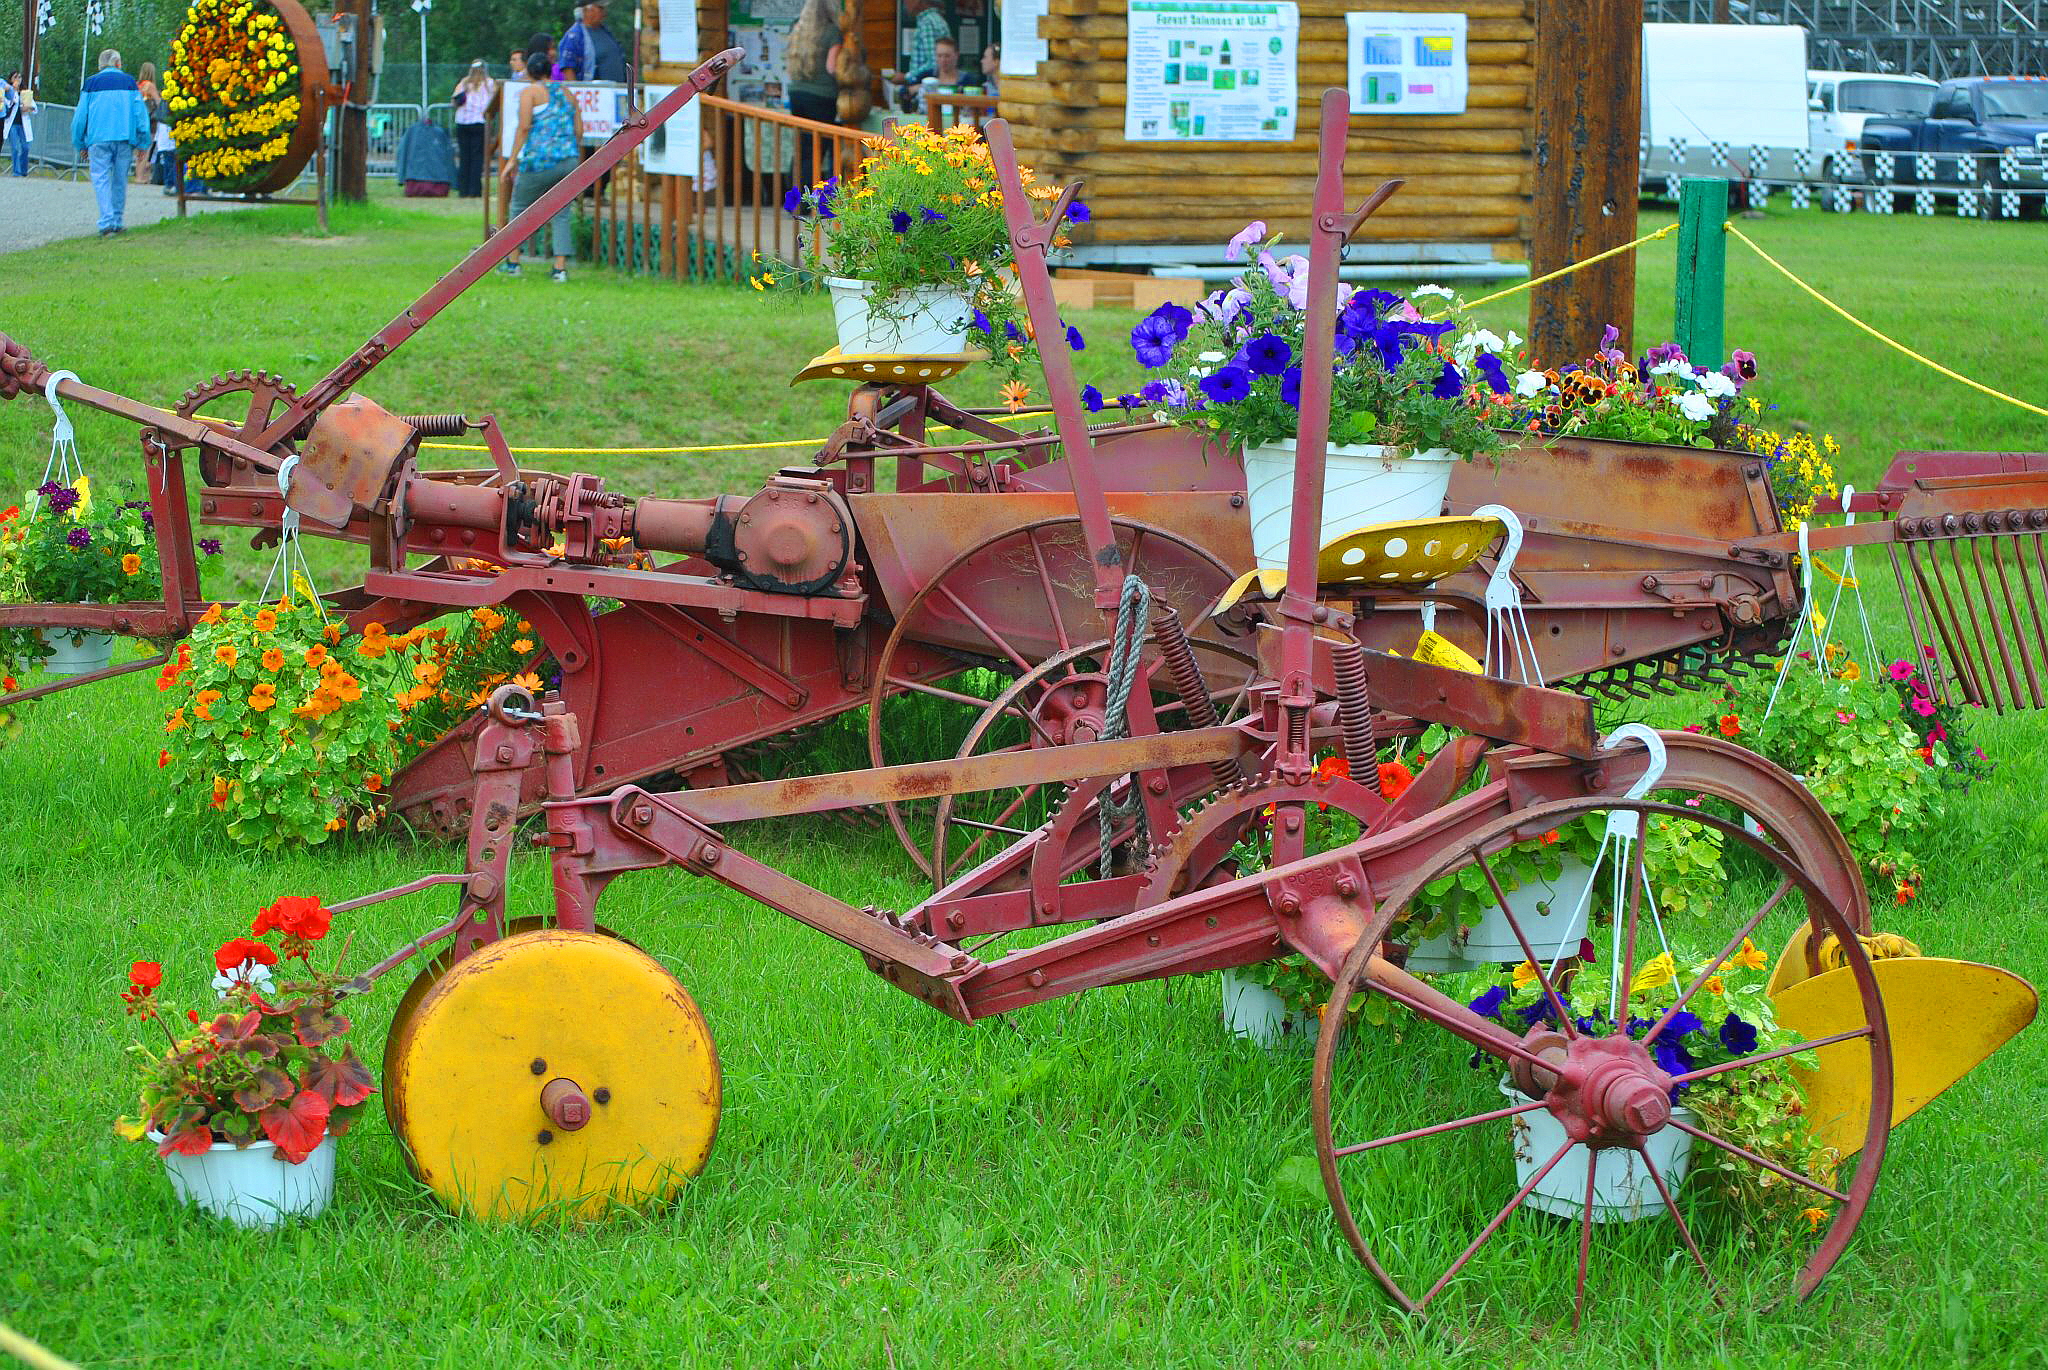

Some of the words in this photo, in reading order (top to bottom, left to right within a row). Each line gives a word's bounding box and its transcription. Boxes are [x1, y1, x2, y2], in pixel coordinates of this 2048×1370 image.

[1156, 13, 1188, 25] Forest
[1190, 14, 1233, 26] Sciences
[1235, 15, 1246, 26] at
[1248, 15, 1268, 26] UAF
